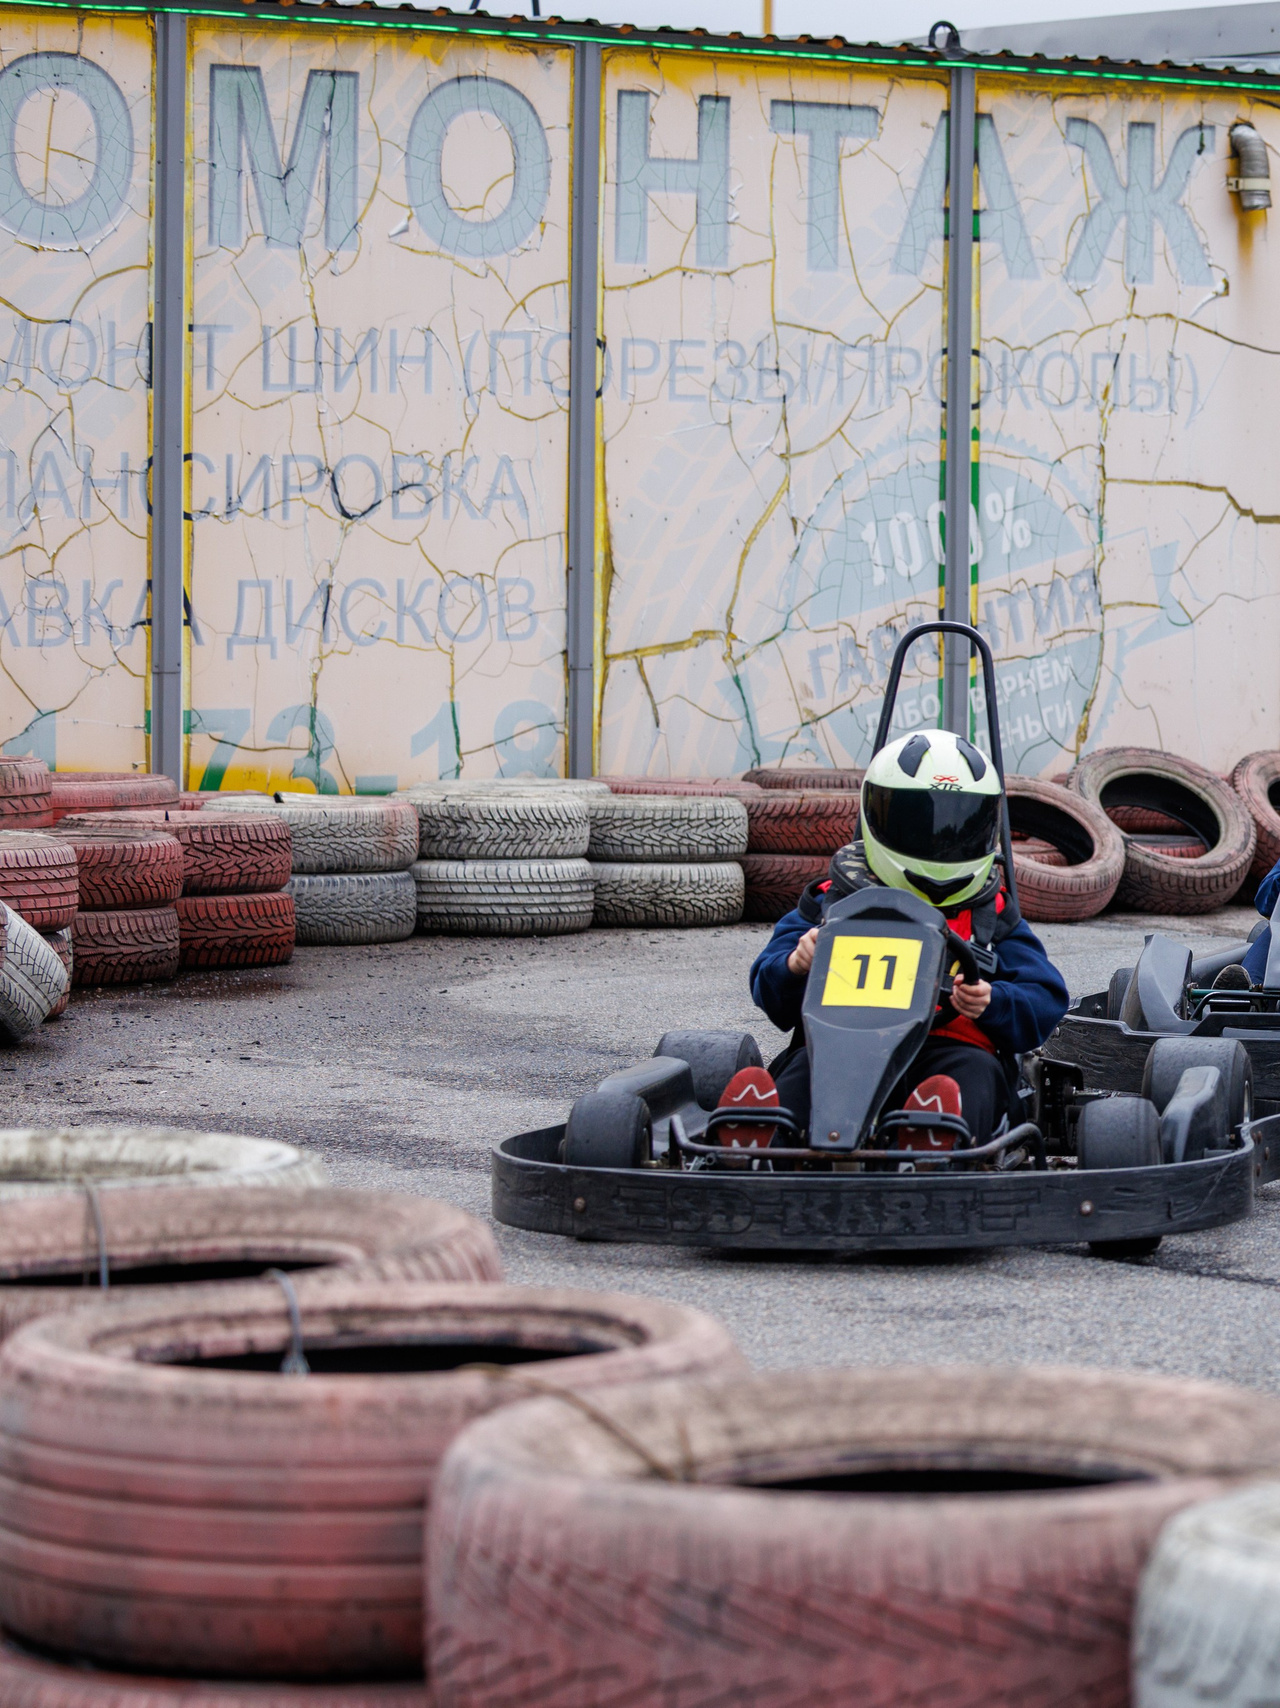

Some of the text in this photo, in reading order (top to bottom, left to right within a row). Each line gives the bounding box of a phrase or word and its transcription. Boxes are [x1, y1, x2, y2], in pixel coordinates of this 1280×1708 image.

[262, 325, 433, 394] ШИН
[227, 578, 539, 660] ДИСКОВ
[853, 954, 897, 990] 11
